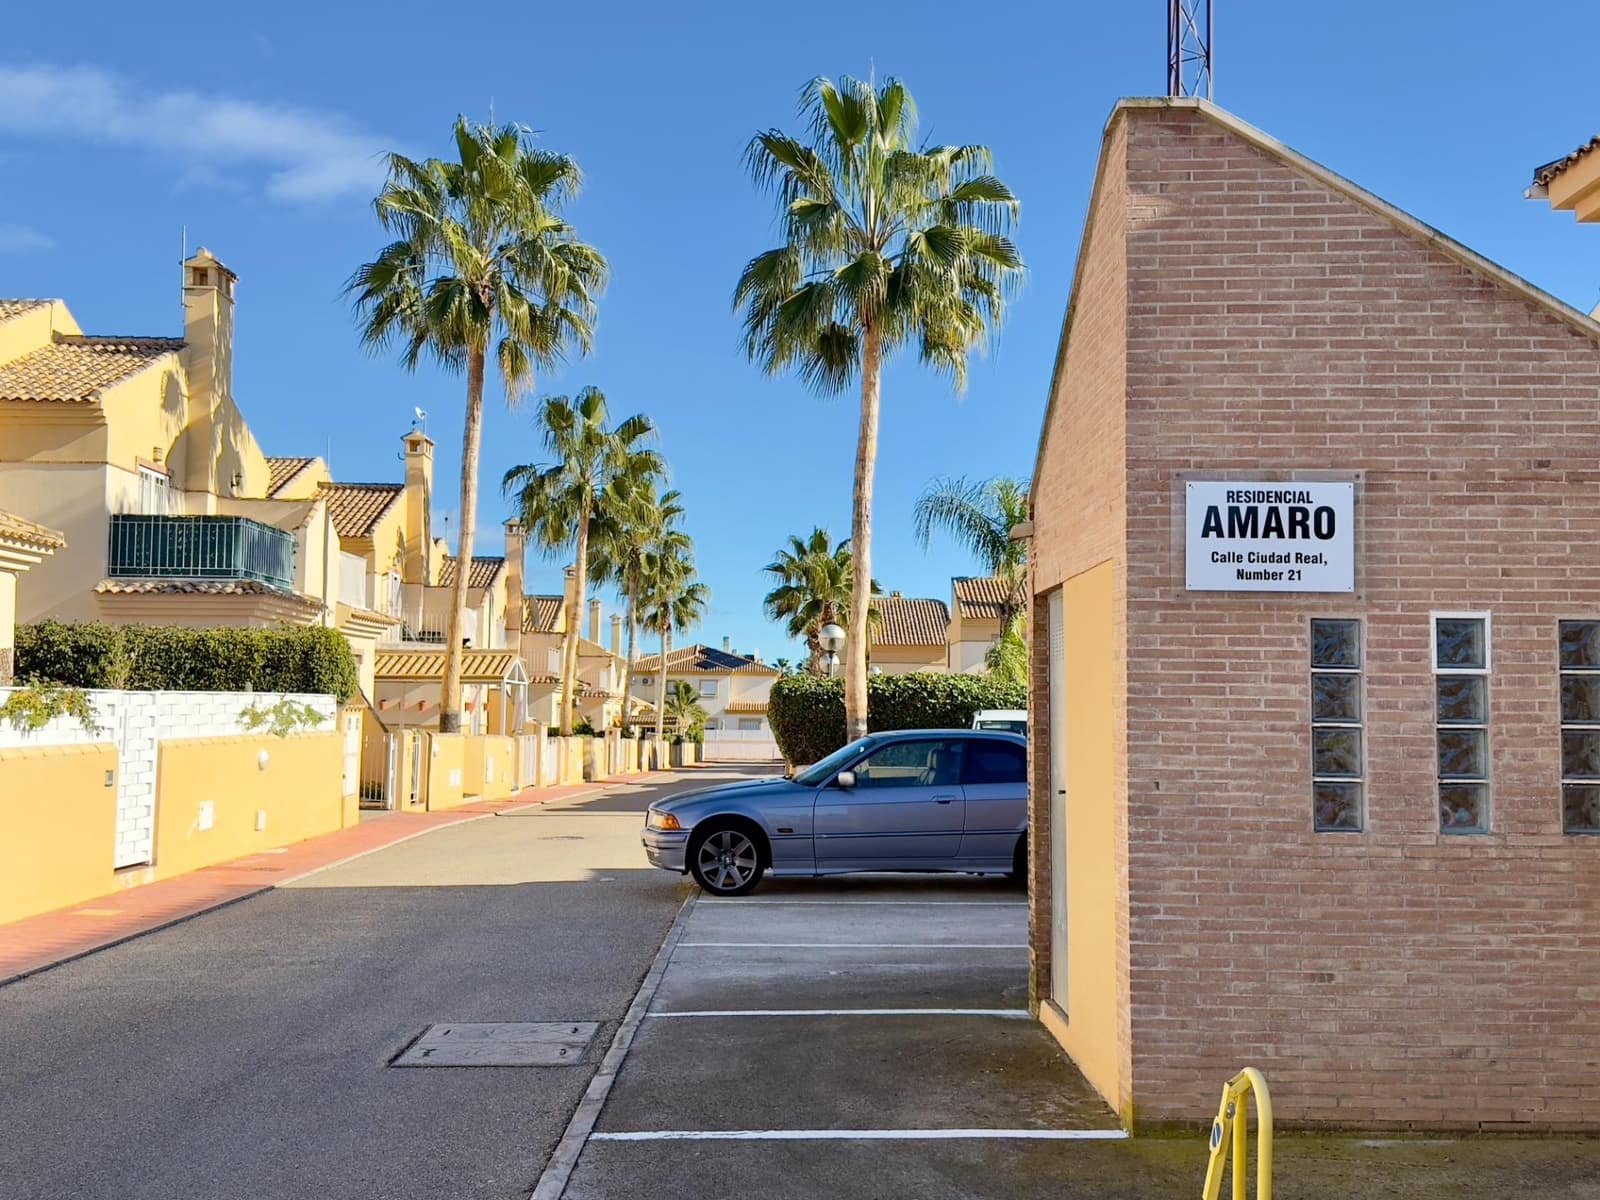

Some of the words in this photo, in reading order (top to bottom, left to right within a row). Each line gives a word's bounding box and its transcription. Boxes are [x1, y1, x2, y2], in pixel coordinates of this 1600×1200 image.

[1226, 490, 1313, 504] RESIDENCIAL
[1201, 505, 1336, 540] AMARO
[1211, 551, 1243, 564] Calle
[1247, 552, 1291, 564] Ciudad
[1295, 552, 1328, 566] Real,
[1236, 568, 1284, 581] Number
[1288, 569, 1302, 581] 21
